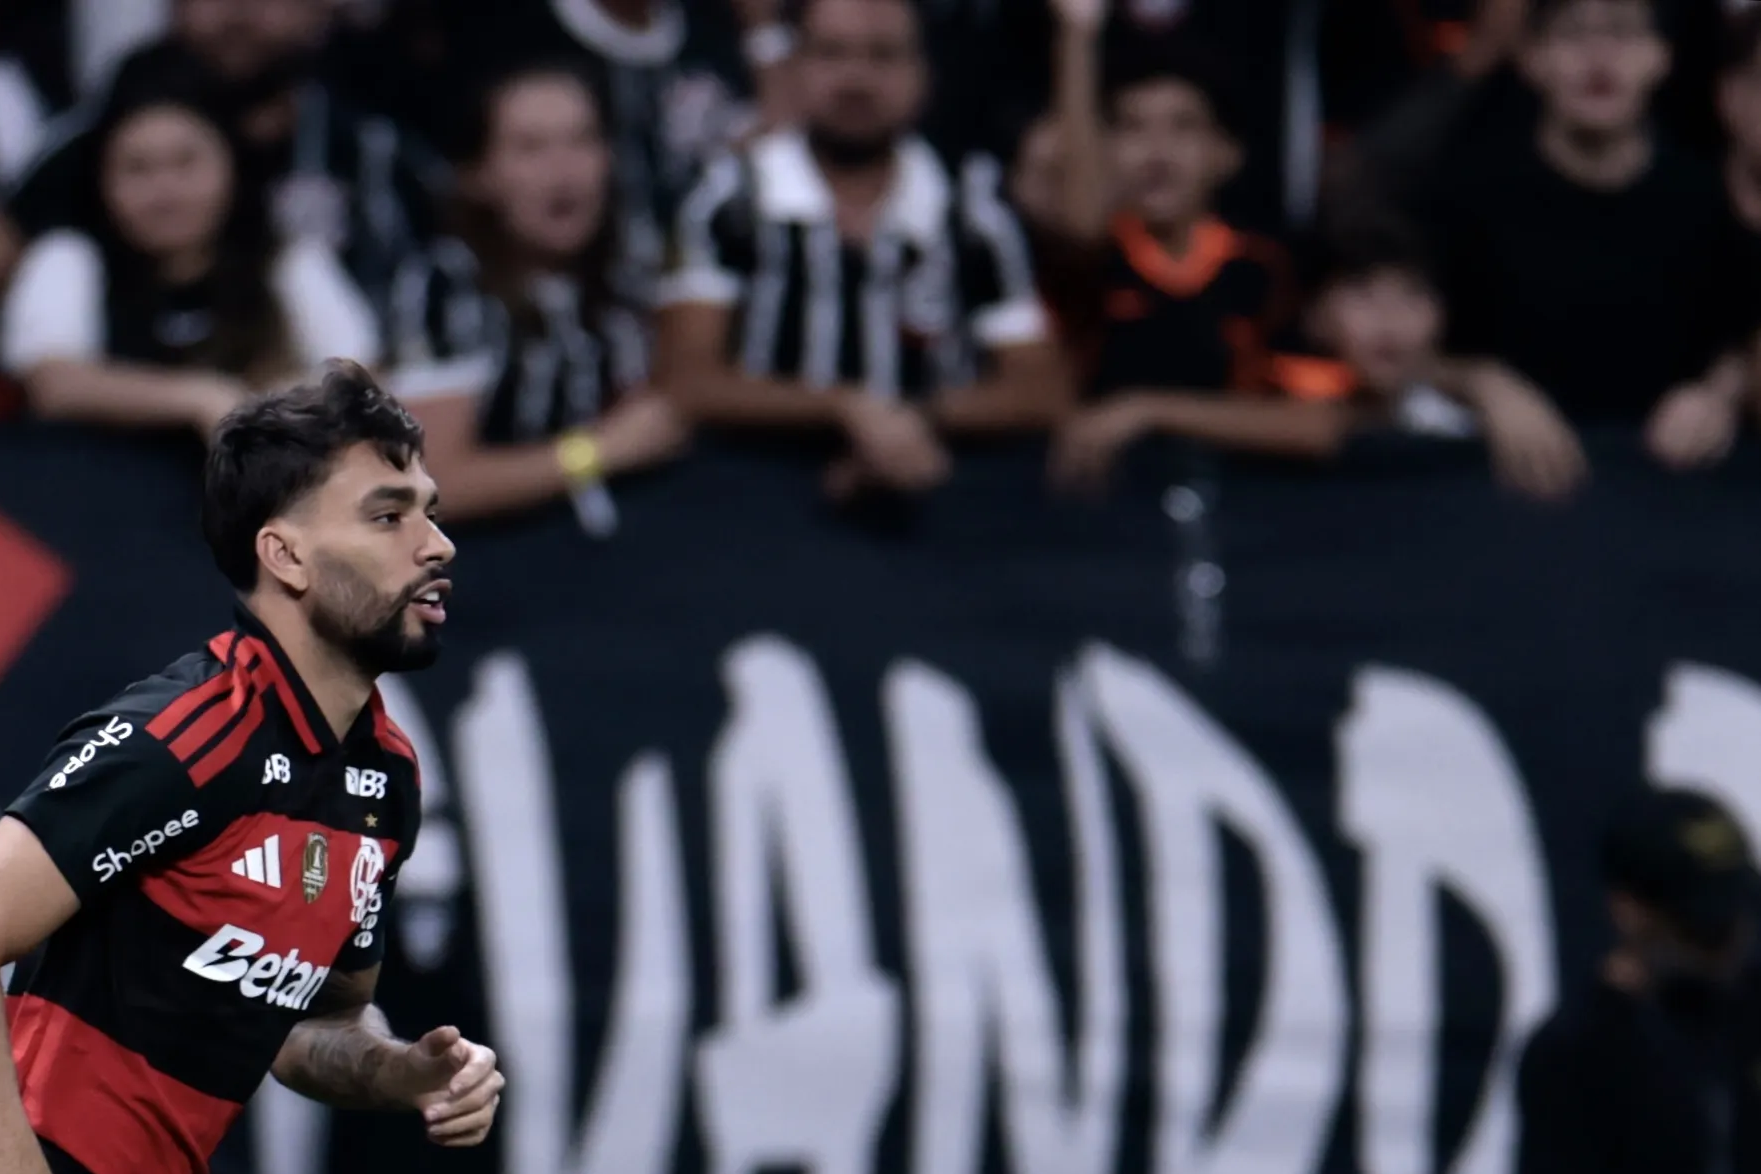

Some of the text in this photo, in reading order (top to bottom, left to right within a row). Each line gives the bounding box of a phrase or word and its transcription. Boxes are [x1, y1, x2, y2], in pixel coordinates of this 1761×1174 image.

[45, 715, 133, 791] Shope
[92, 809, 200, 883] Shopee
[182, 922, 331, 1012] Betan
